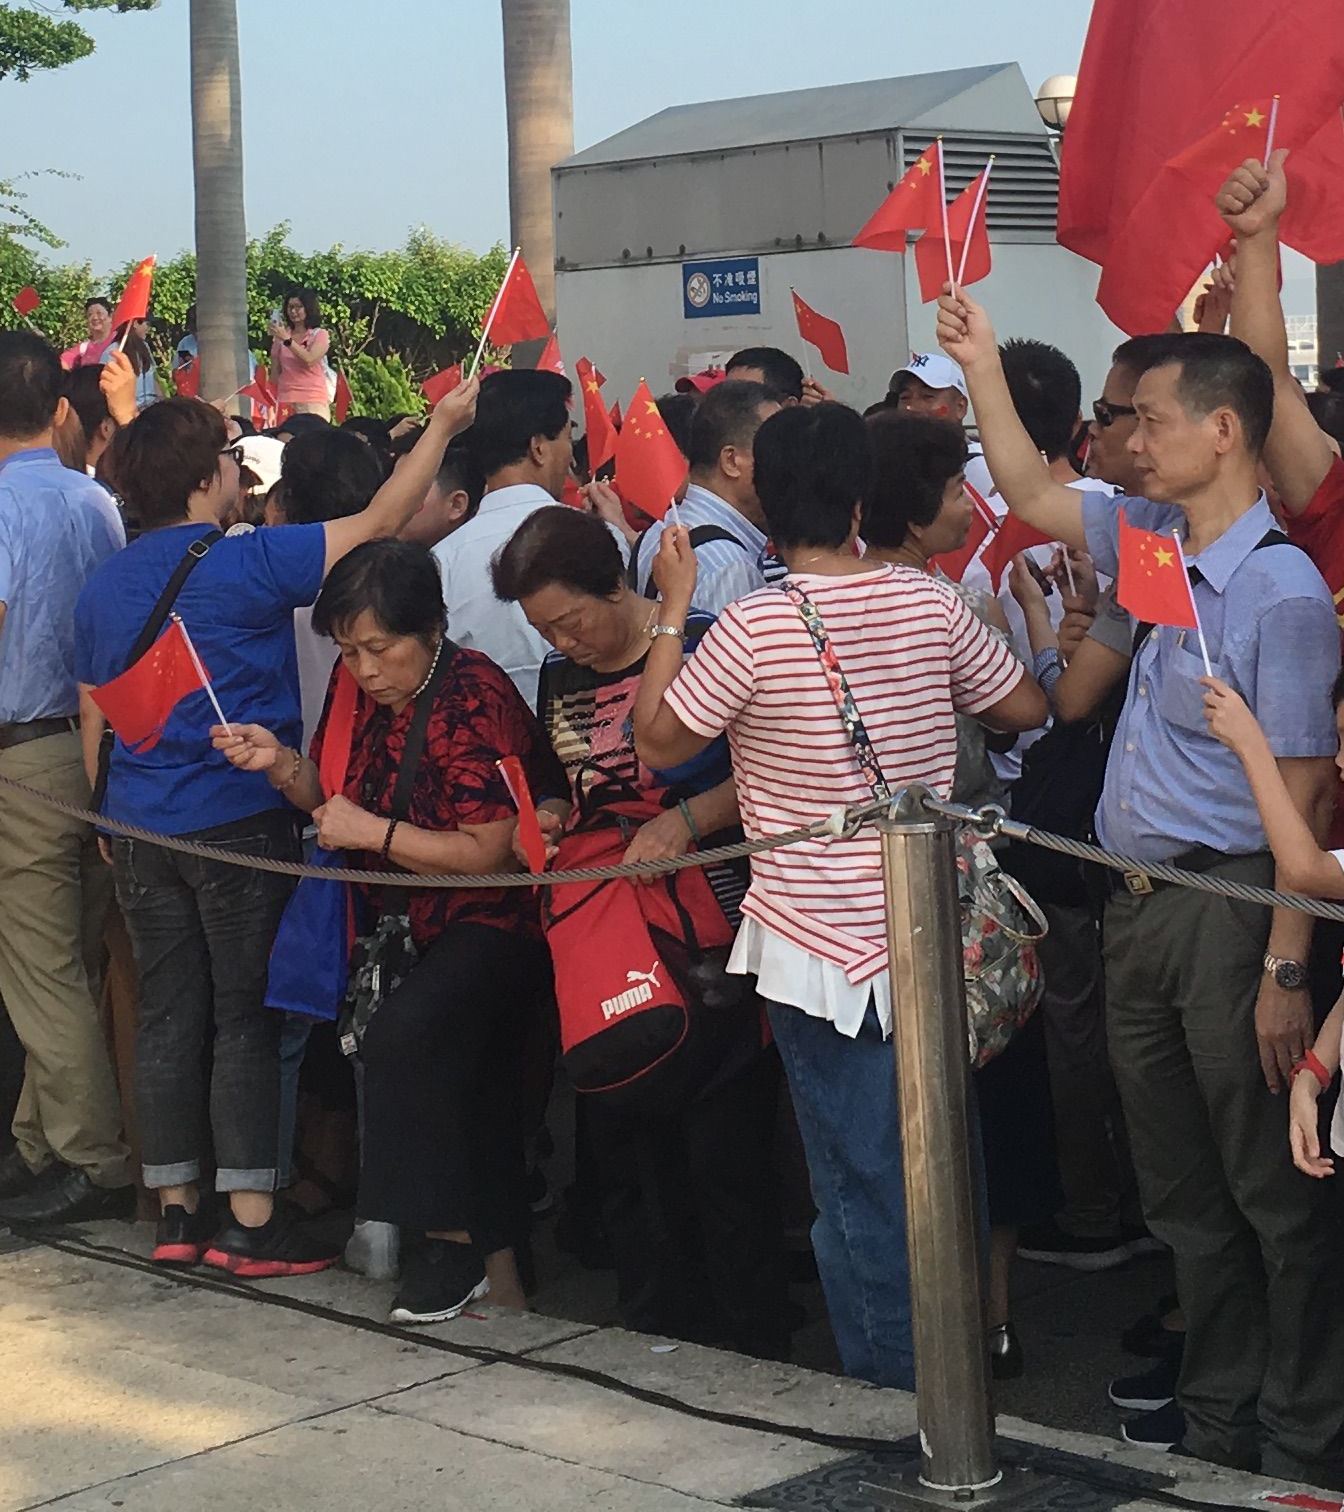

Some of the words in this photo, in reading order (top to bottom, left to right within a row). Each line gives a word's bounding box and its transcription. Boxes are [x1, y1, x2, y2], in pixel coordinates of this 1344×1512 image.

[712, 292, 724, 304] No
[724, 291, 758, 304] Smoking
[600, 982, 654, 1021] PUMA
